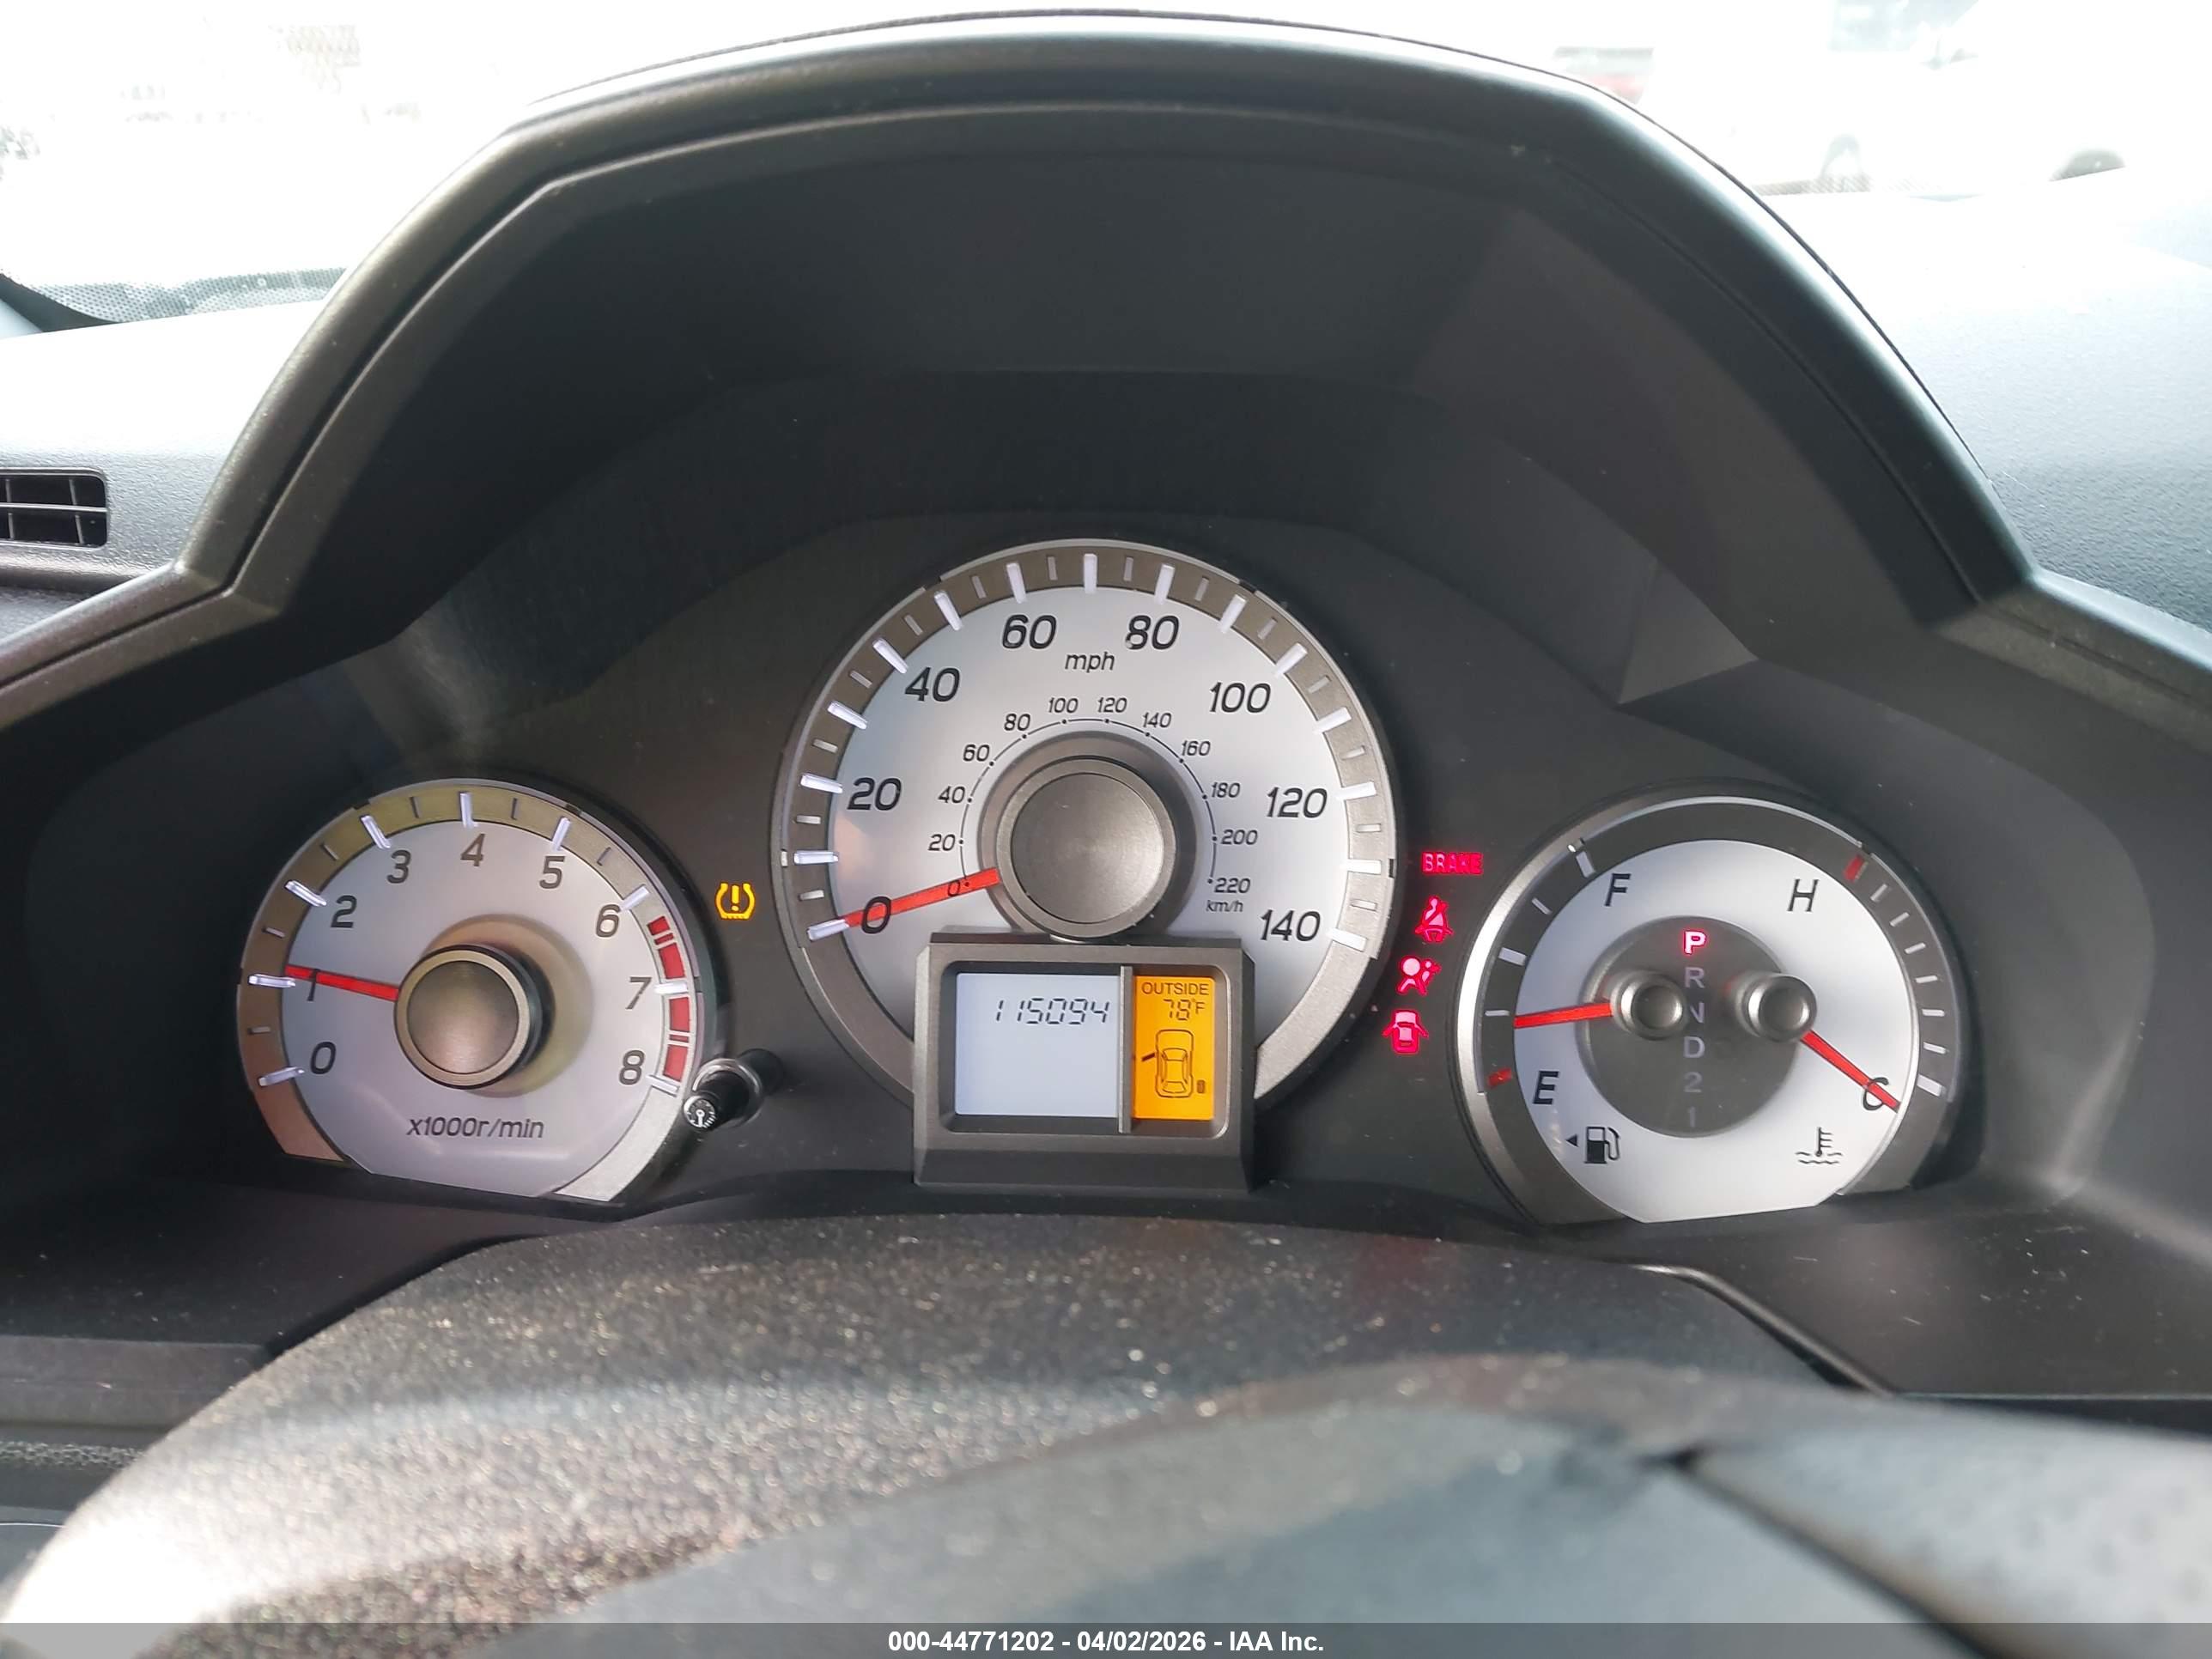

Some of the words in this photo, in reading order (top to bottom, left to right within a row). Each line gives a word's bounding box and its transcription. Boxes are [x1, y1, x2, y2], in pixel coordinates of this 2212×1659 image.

[1002, 615, 1057, 649] 60
[1126, 615, 1180, 650] 80
[1065, 652, 1115, 673] mph
[904, 667, 960, 702] 40
[1208, 682, 1271, 713] 100
[1048, 697, 1079, 714] 100
[1097, 697, 1127, 714] 120
[1004, 713, 1031, 732] 80
[1142, 712, 1172, 729] 140
[963, 744, 990, 763] 60
[1181, 740, 1212, 757] 160
[847, 777, 902, 811] 20
[938, 786, 966, 805] 40
[1211, 782, 1241, 799] 180
[1267, 787, 1328, 818] 120
[460, 833, 487, 867] 4
[927, 833, 956, 852] 20
[1221, 829, 1259, 847] 200
[386, 849, 412, 884] 3
[538, 855, 566, 890] 5
[1422, 852, 1484, 875] BRAKE
[1213, 877, 1251, 895] 220
[1604, 872, 1631, 908] F
[1786, 878, 1820, 913] H
[330, 894, 358, 929] 2
[595, 903, 621, 938] 6
[861, 896, 892, 935] 0
[1206, 898, 1244, 915] km/h
[1259, 909, 1321, 942] 140
[1683, 929, 1707, 955] P
[306, 967, 320, 1002] 1
[626, 975, 653, 1011] 7
[1140, 981, 1210, 997] OUTSIDE
[1684, 967, 1706, 990] R
[995, 997, 1110, 1025] 115094
[309, 1041, 337, 1075] 0
[1684, 1036, 1705, 1060] D
[618, 1049, 646, 1085] 8
[1533, 1069, 1560, 1105] E
[1684, 1072, 1704, 1094] 2
[1861, 1077, 1890, 1111] C
[406, 1116, 544, 1140] x1000r/min
